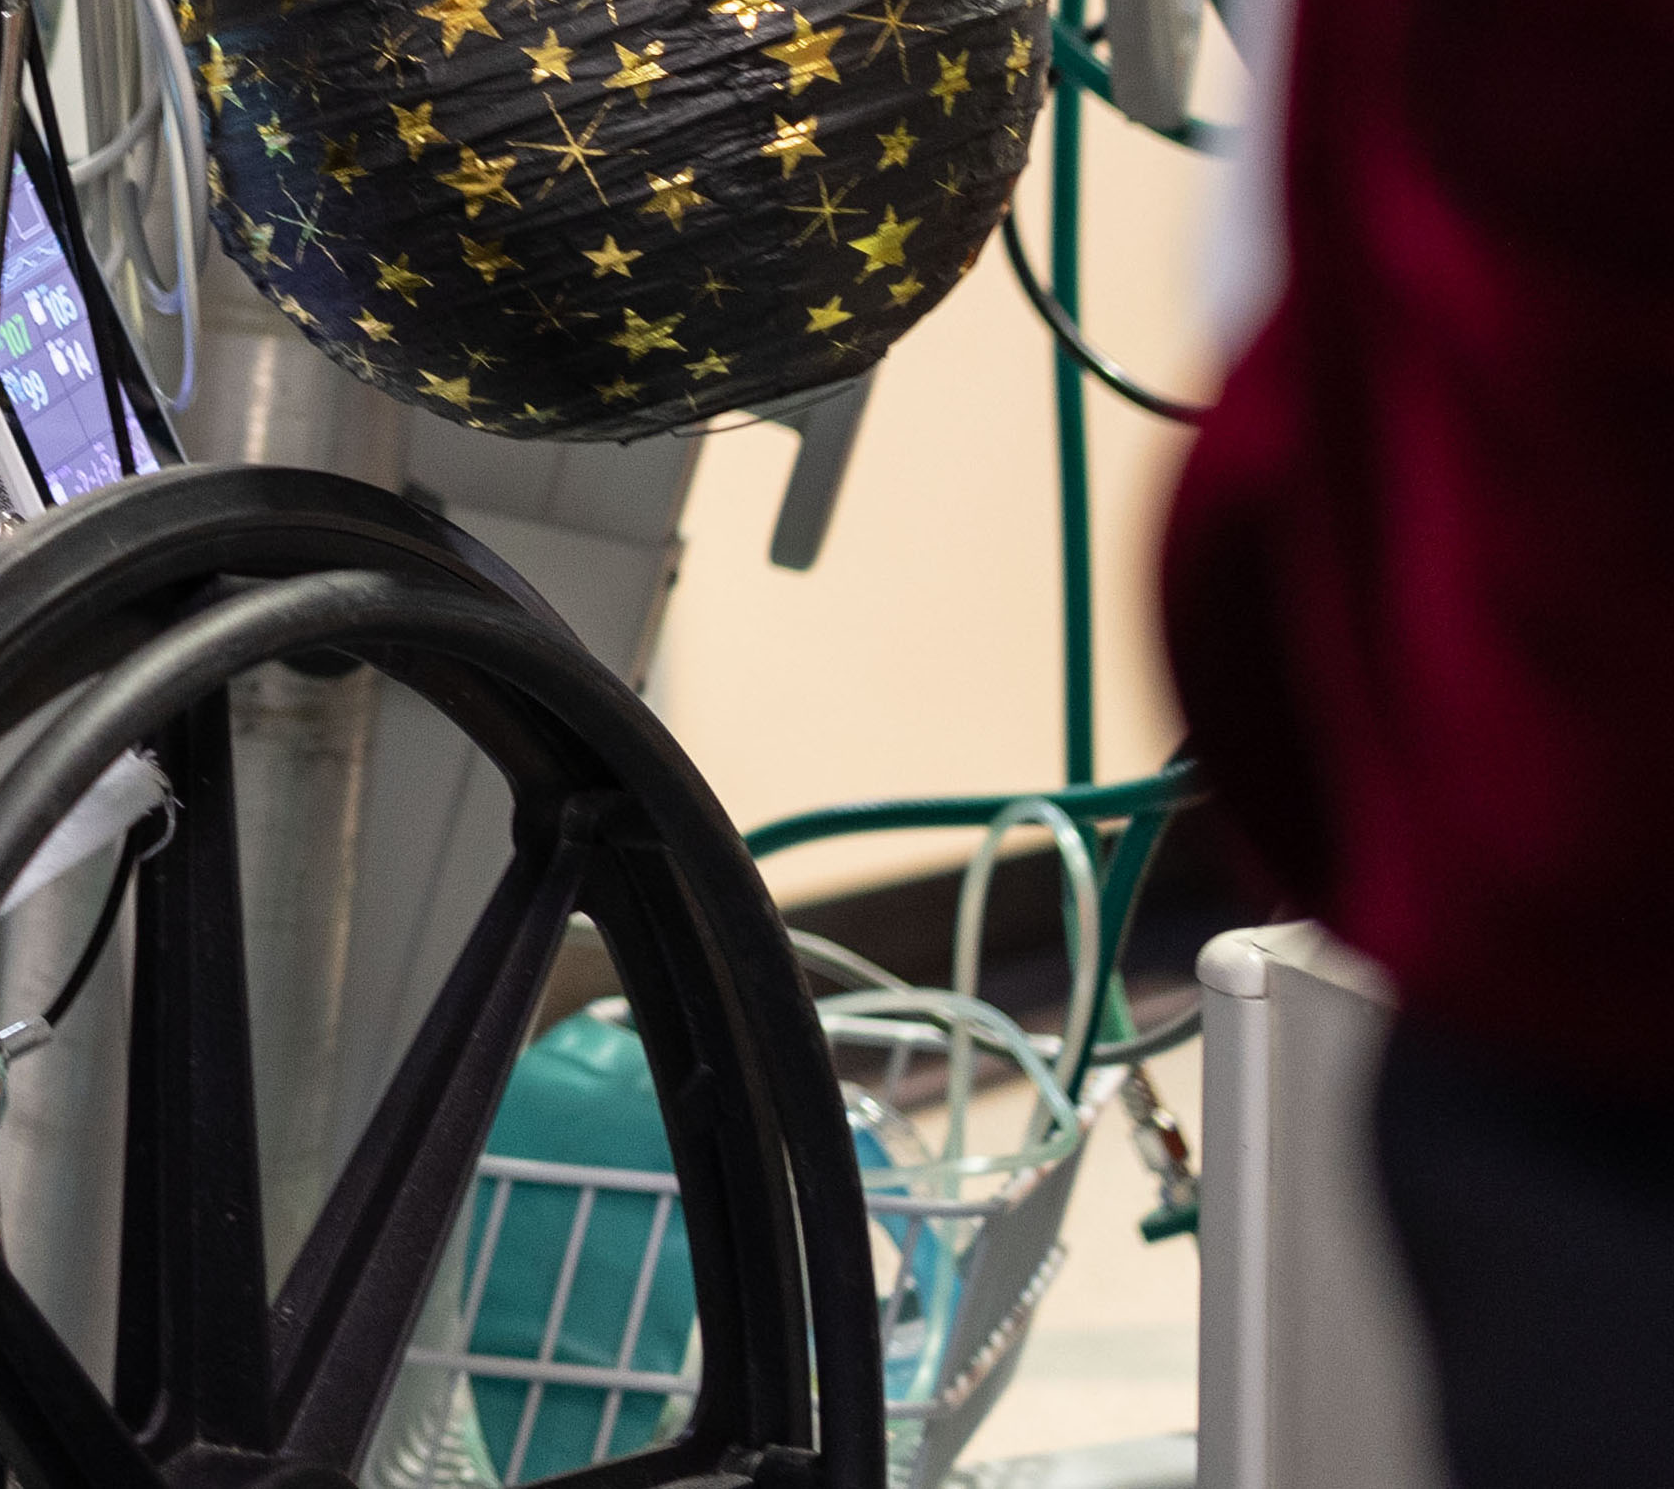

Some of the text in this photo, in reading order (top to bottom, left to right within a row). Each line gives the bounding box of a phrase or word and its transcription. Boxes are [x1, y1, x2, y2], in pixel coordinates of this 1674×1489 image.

[43, 285, 78, 330] 105
[65, 340, 93, 381] 14
[20, 369, 49, 411] 99
